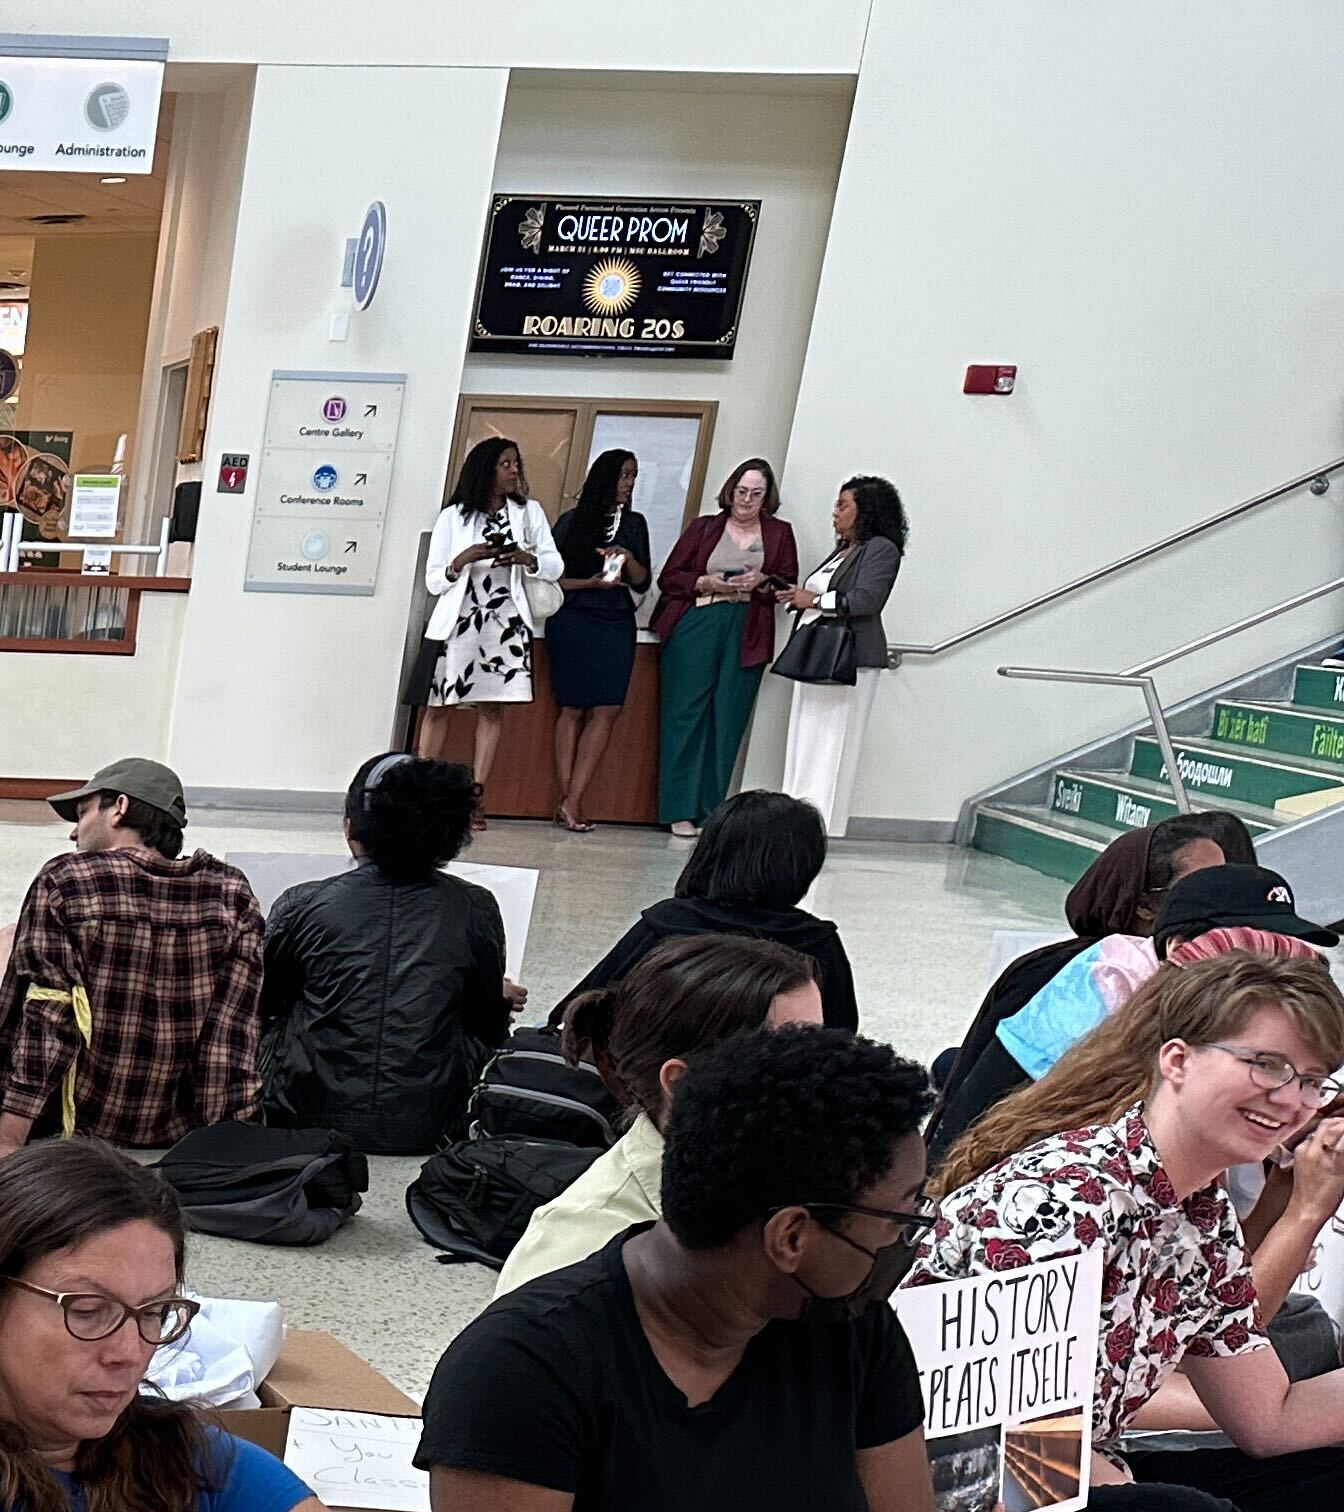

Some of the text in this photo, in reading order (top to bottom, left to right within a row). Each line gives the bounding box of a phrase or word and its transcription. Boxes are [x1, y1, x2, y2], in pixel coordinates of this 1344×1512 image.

[55, 144, 146, 159] Administration
[557, 215, 688, 243] QUEER PROM
[522, 315, 635, 338] ROARING
[299, 427, 364, 440] Centre Gallery
[223, 456, 248, 468] AED
[280, 494, 364, 506] Conference Rooms
[277, 562, 348, 576] Student Lounge
[1159, 751, 1233, 788] Дбродошли
[940, 1260, 1079, 1351] HISTORY
[918, 1335, 1078, 1431] PEATS ITSELF.
